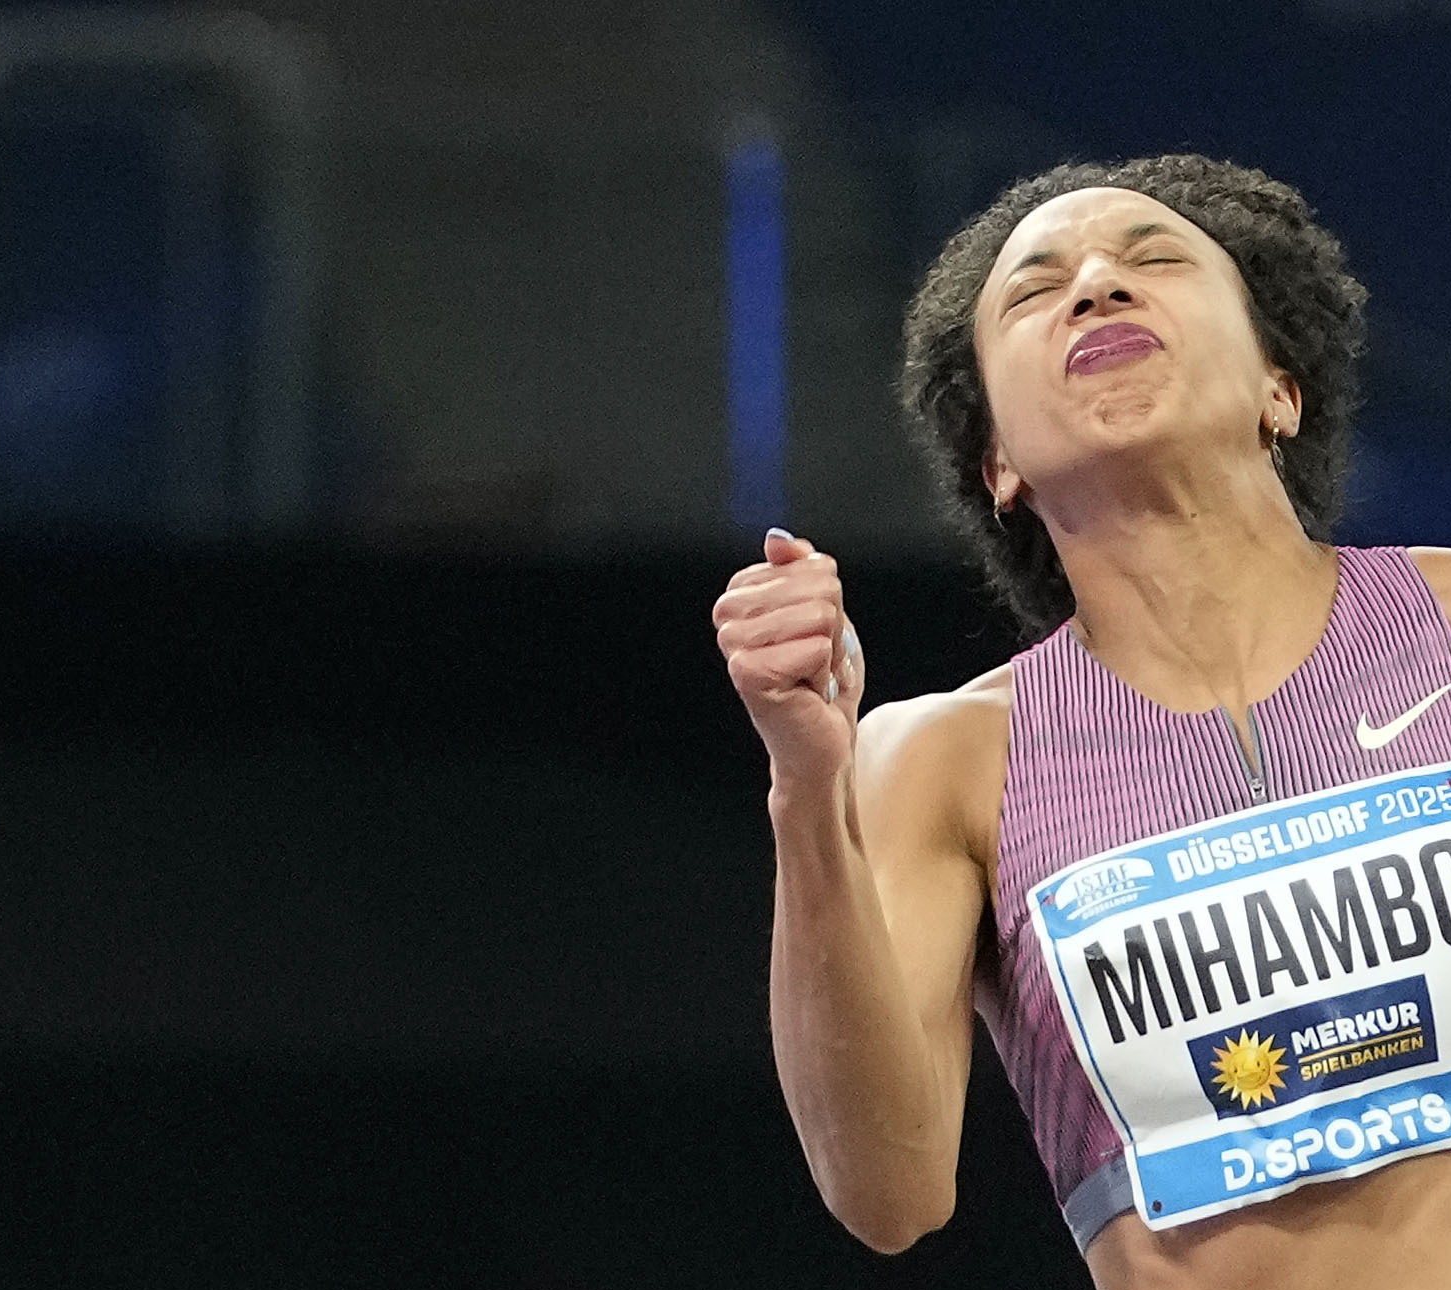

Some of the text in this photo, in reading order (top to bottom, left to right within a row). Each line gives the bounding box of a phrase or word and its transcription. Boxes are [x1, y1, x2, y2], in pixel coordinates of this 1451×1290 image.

[1167, 801, 1370, 883] DÜSSELDORF
[1074, 863, 1129, 898] ISTAF
[1291, 1002, 1420, 1055] MERKUR
[1301, 1036, 1424, 1082] SPIELBANKEN
[1221, 1093, 1451, 1192] D.SPORTS
